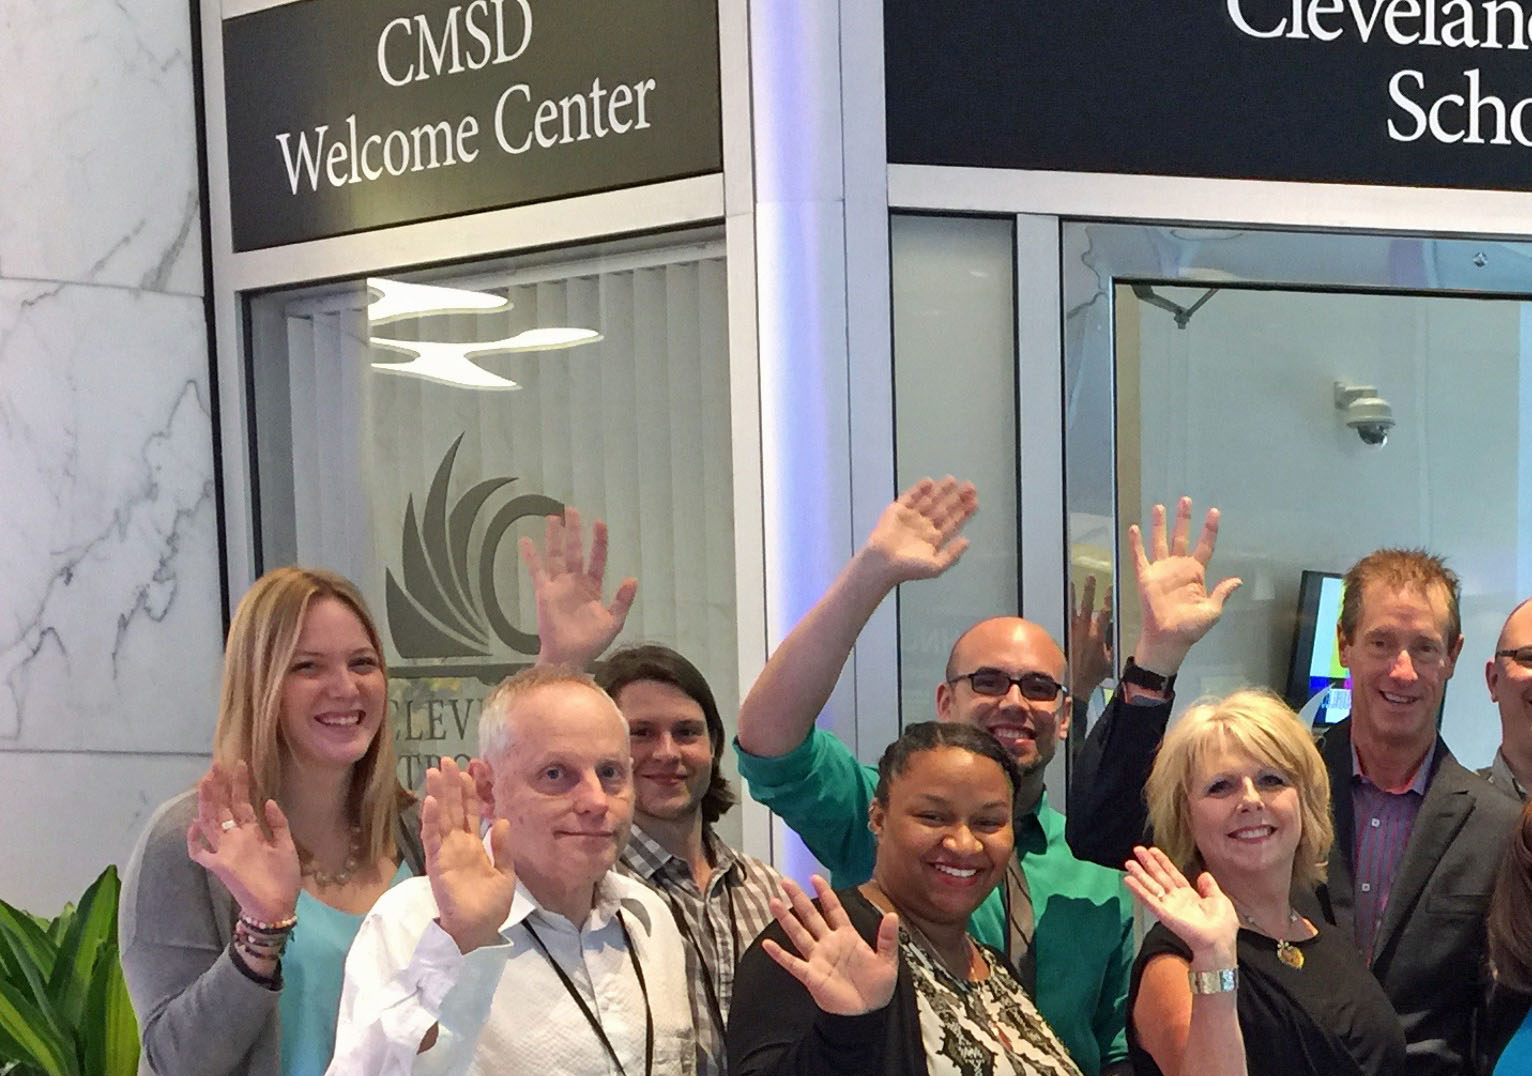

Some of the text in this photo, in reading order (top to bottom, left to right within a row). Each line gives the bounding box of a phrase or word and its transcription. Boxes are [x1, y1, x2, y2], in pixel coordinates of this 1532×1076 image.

[377, 0, 533, 87] CMSD
[275, 77, 656, 195] Welcome Center
